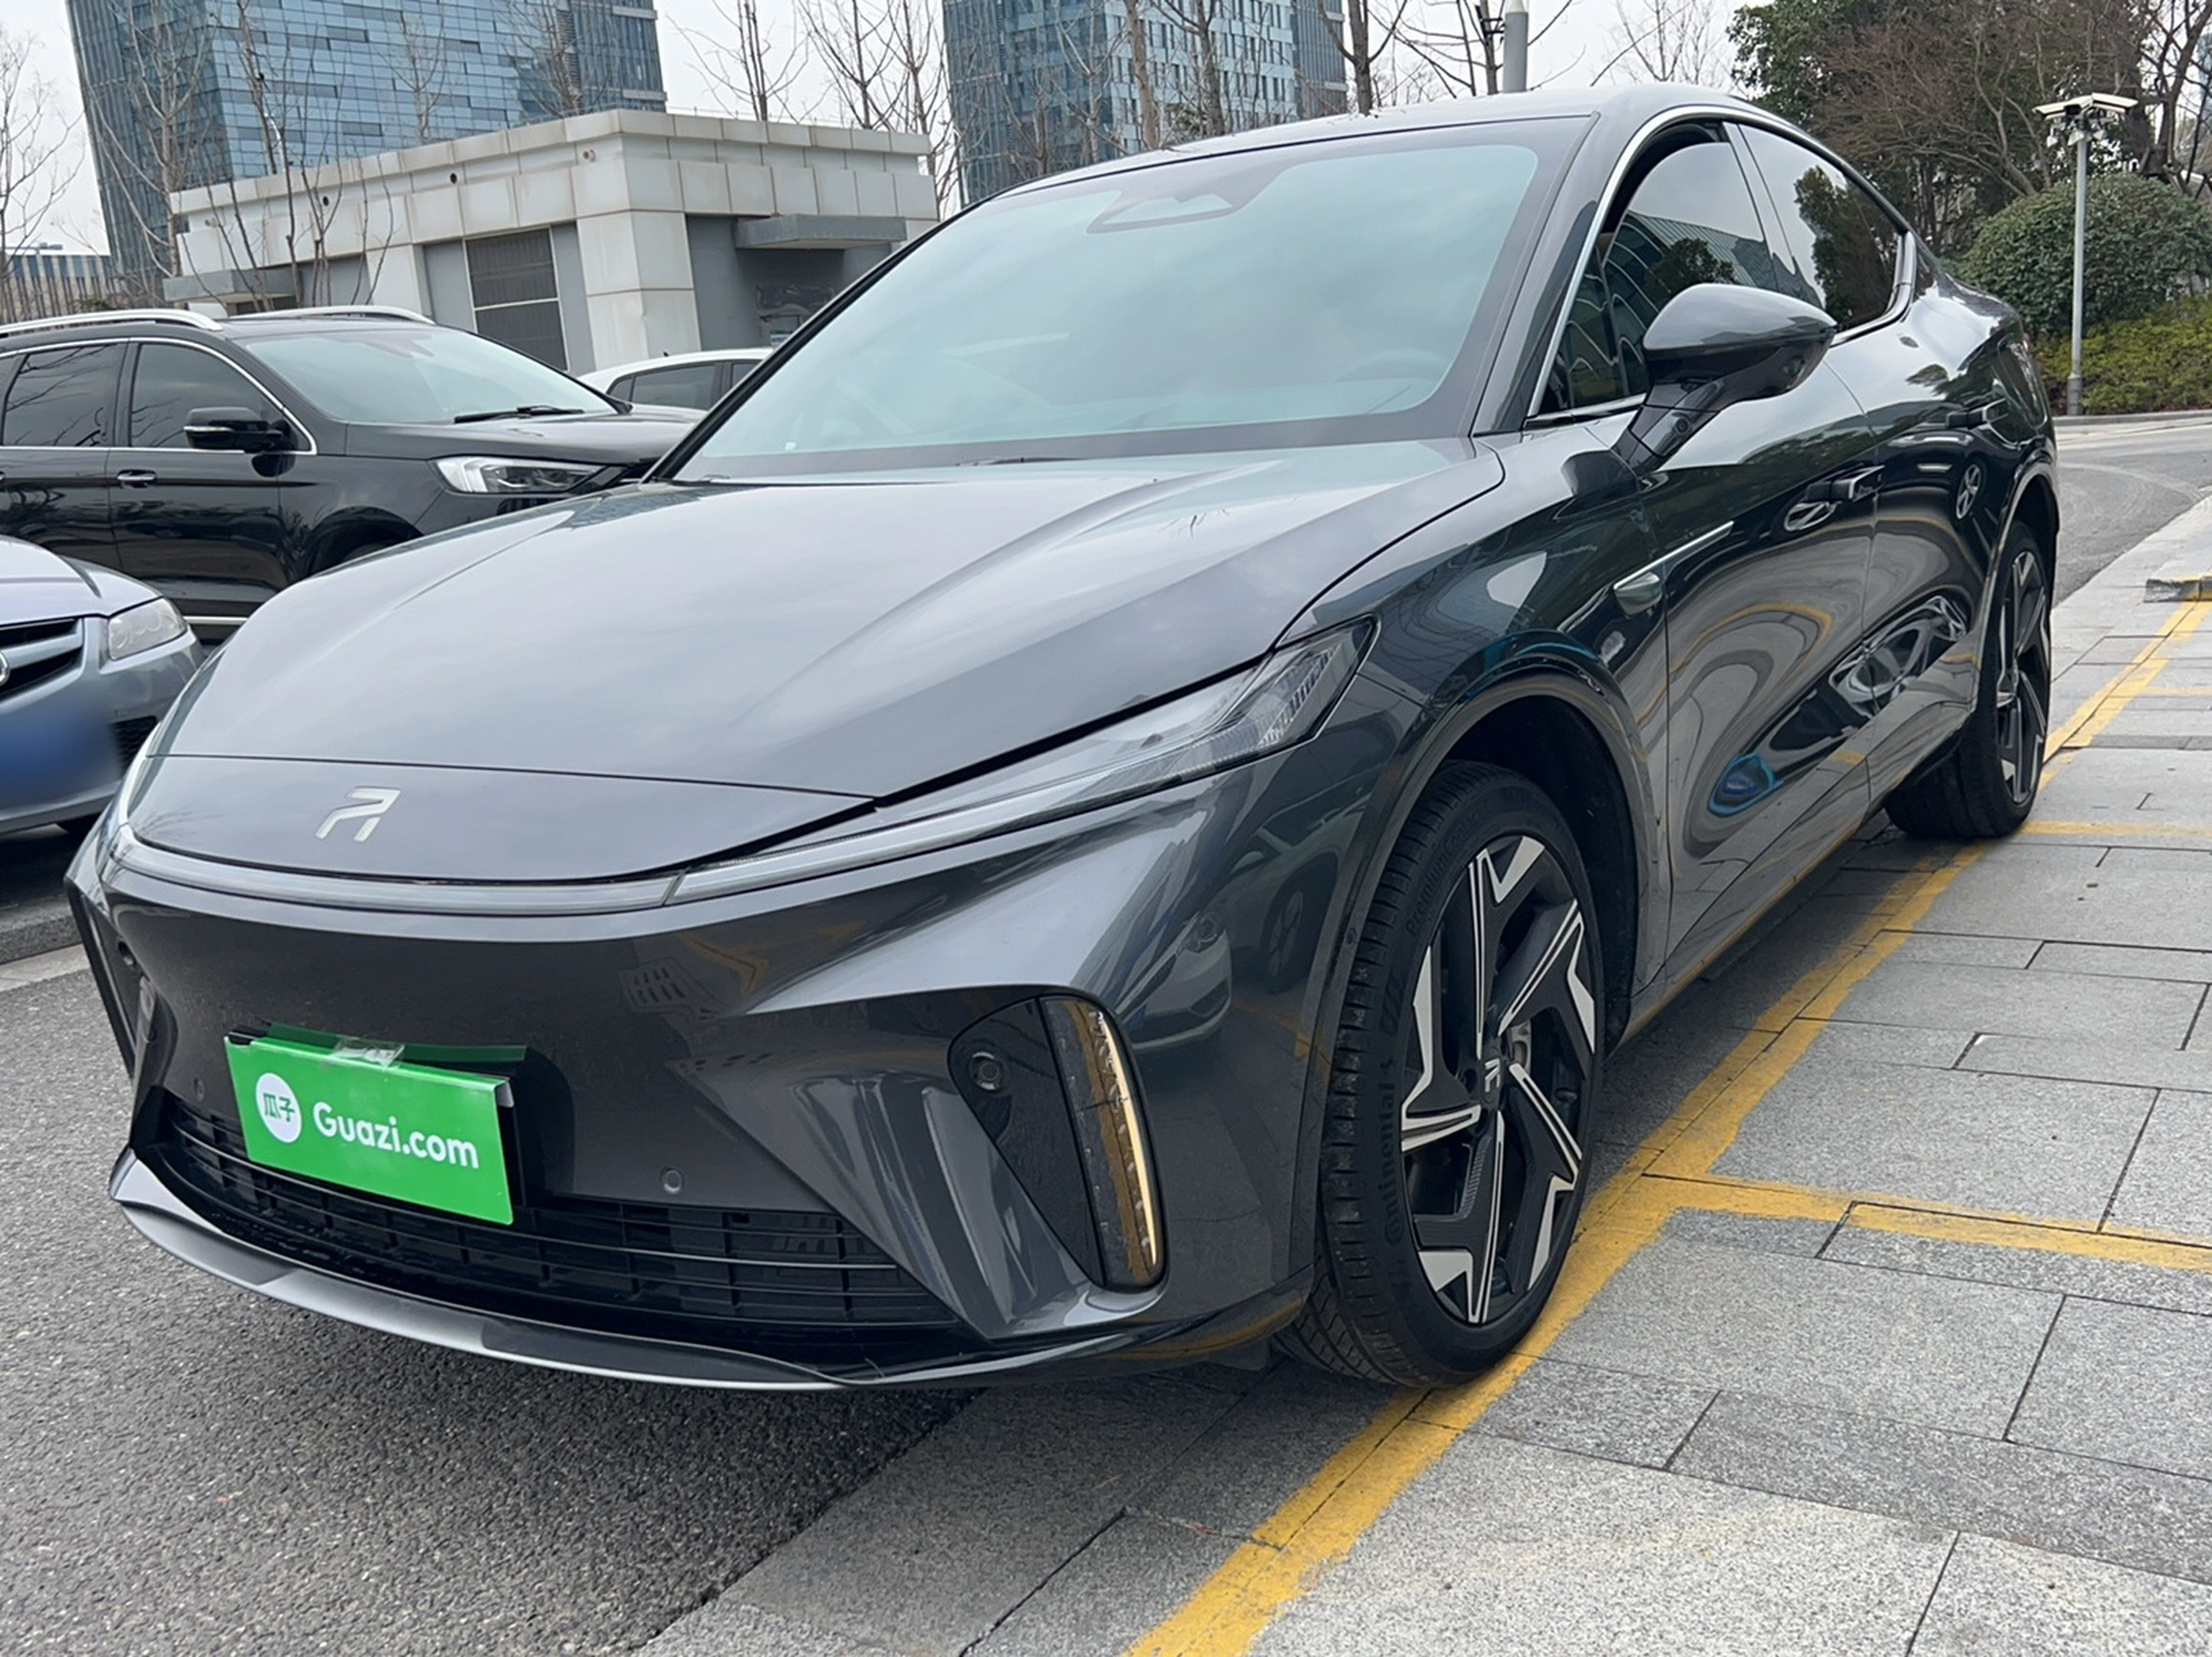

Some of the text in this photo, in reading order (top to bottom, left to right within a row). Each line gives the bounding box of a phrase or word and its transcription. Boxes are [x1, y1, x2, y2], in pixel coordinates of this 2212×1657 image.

[263, 1092, 296, 1122] 瓜子
[313, 1101, 479, 1169] Guazi.com
[1379, 1082, 1404, 1246] Continental
